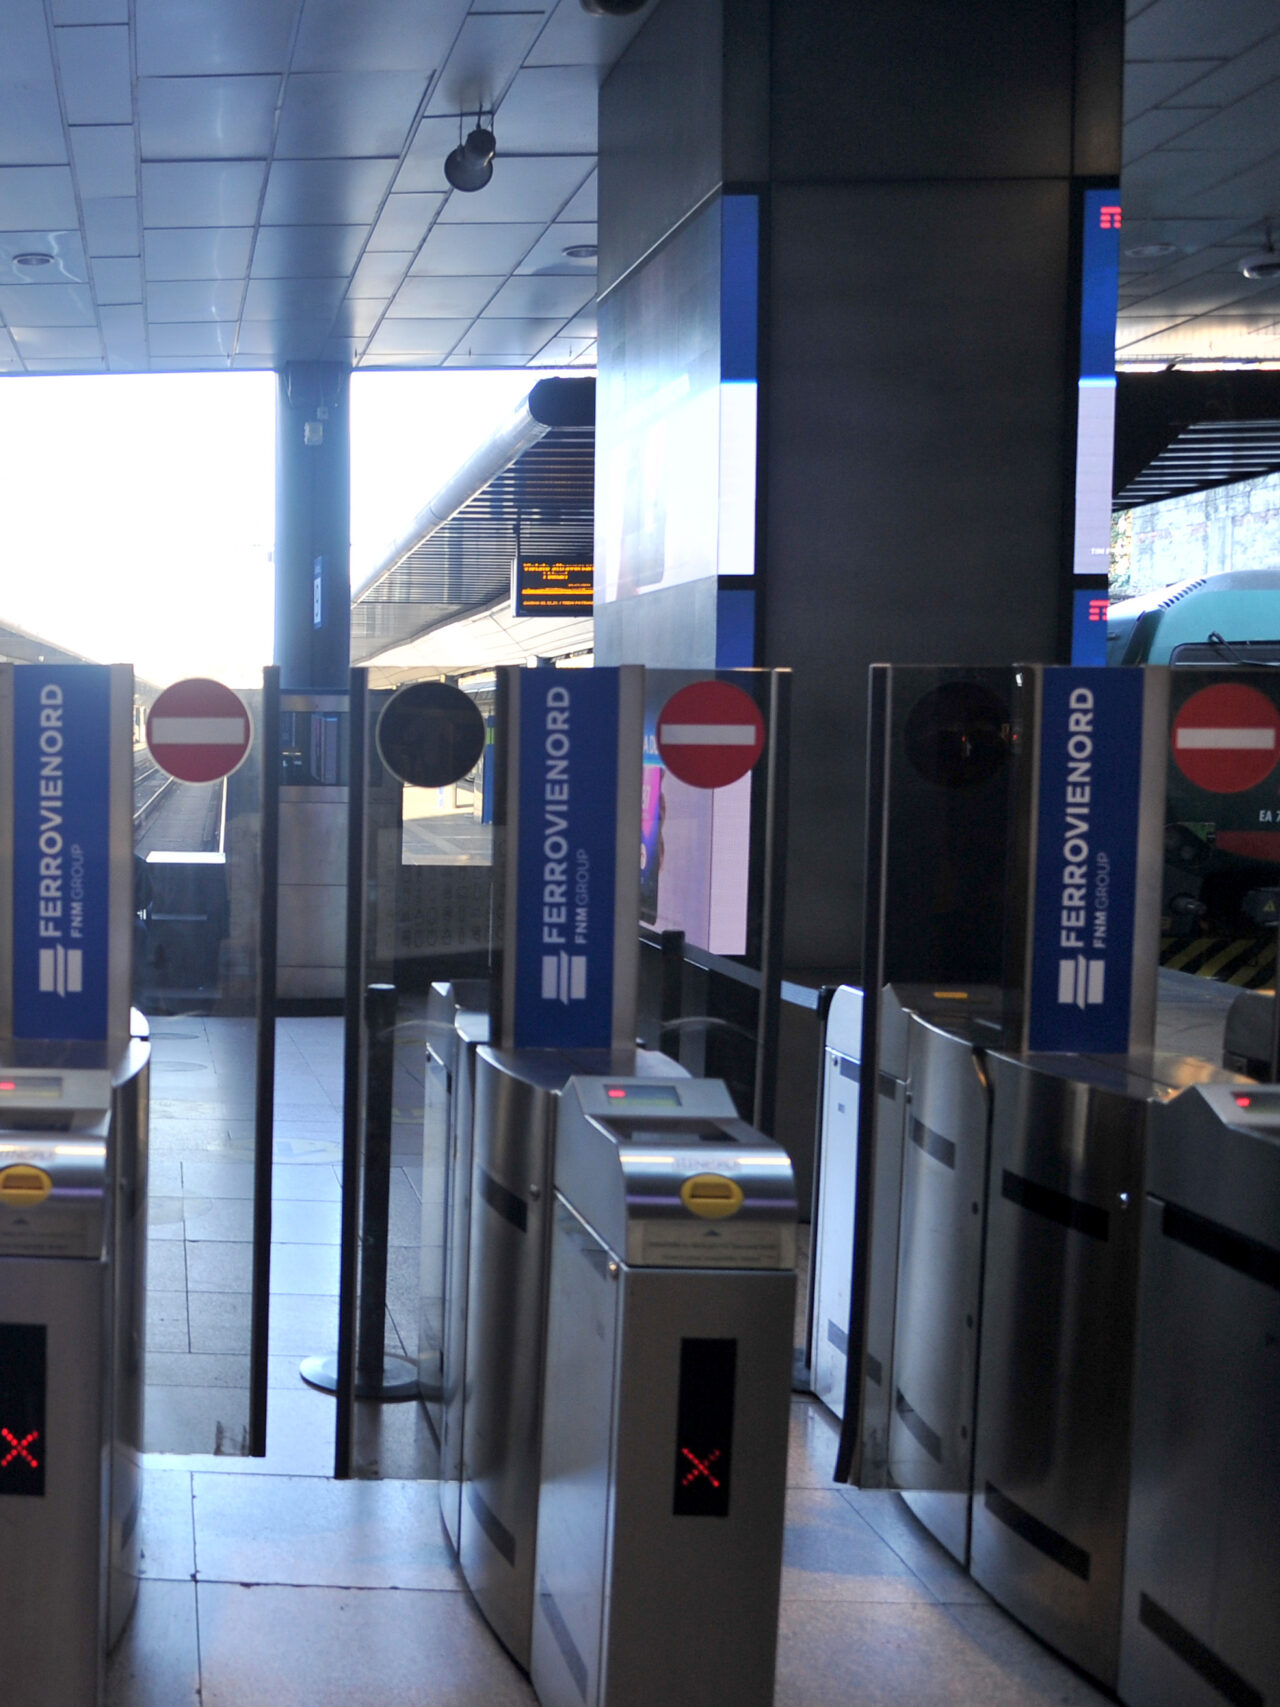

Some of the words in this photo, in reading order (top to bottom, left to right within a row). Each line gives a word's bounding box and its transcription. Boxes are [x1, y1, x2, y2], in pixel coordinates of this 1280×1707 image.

[39, 684, 63, 937] FERROVIENORD
[543, 687, 570, 943] FERROVIENORD
[1060, 688, 1095, 947] FERROVIENORD
[1259, 810, 1272, 822] EA
